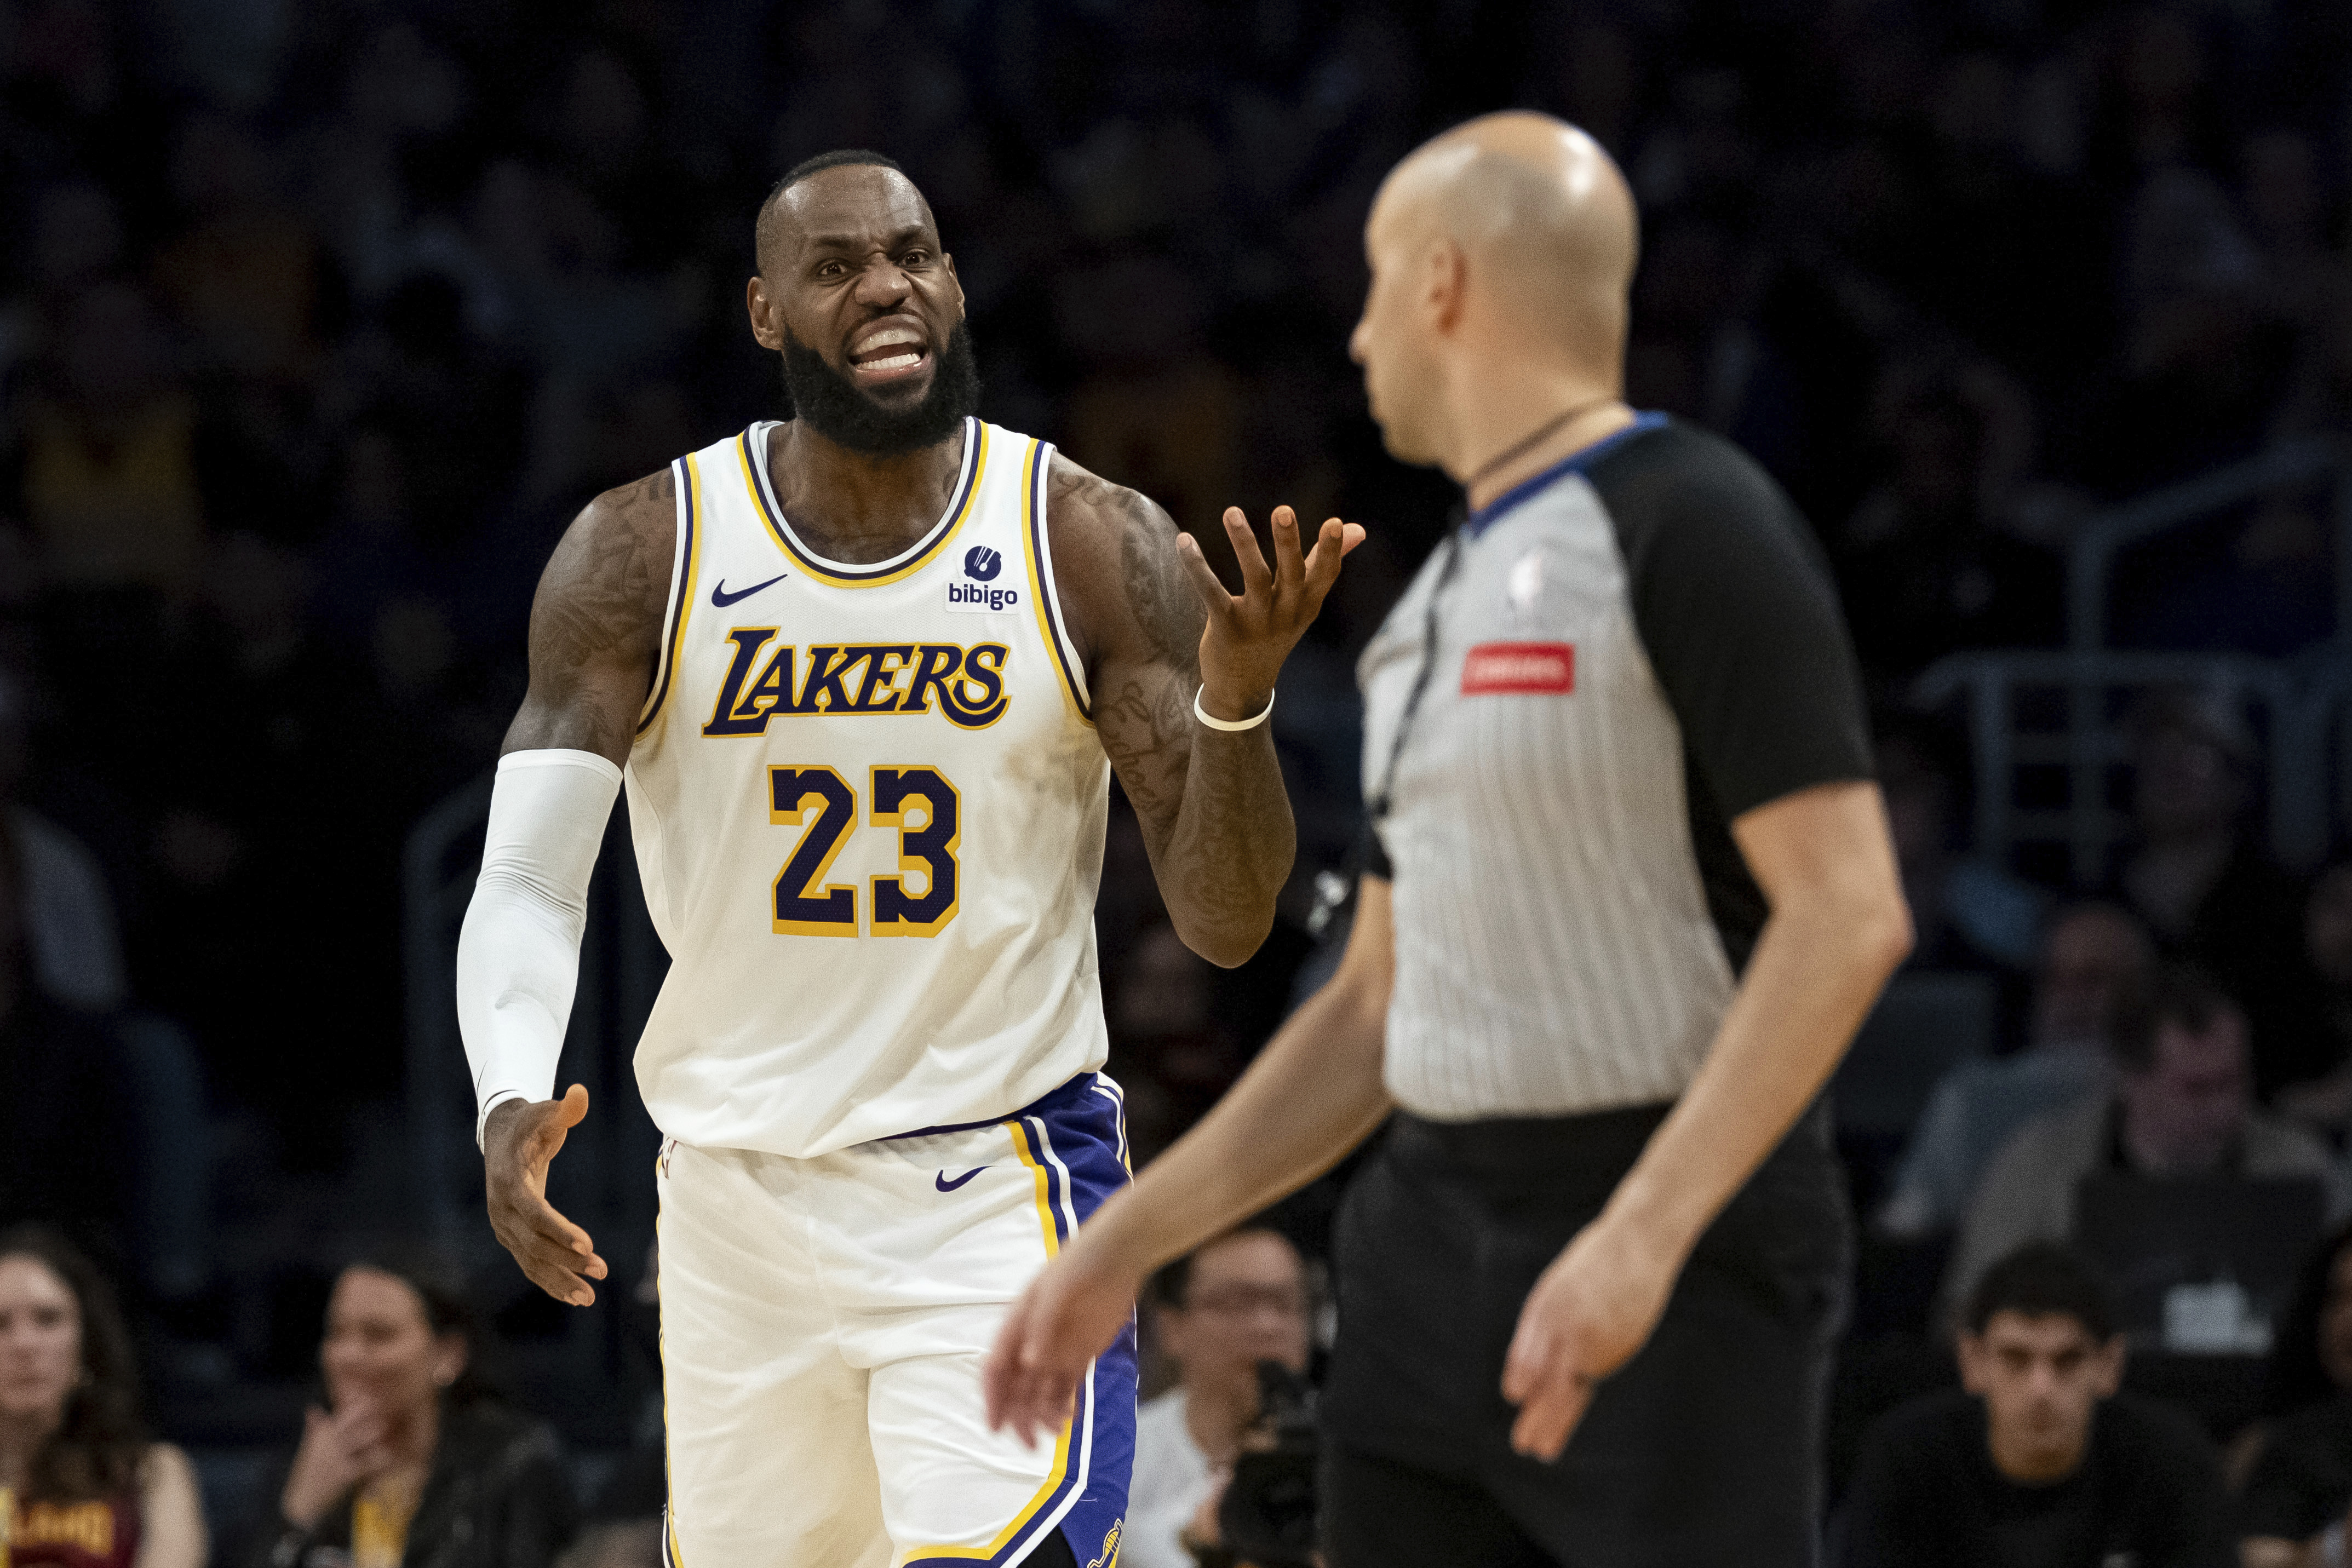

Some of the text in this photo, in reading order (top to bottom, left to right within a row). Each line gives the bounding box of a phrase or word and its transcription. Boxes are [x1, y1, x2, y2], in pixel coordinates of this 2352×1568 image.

[949, 583, 1018, 611] bibigo
[702, 625, 1012, 738] LAKERS
[767, 764, 961, 938] 23
